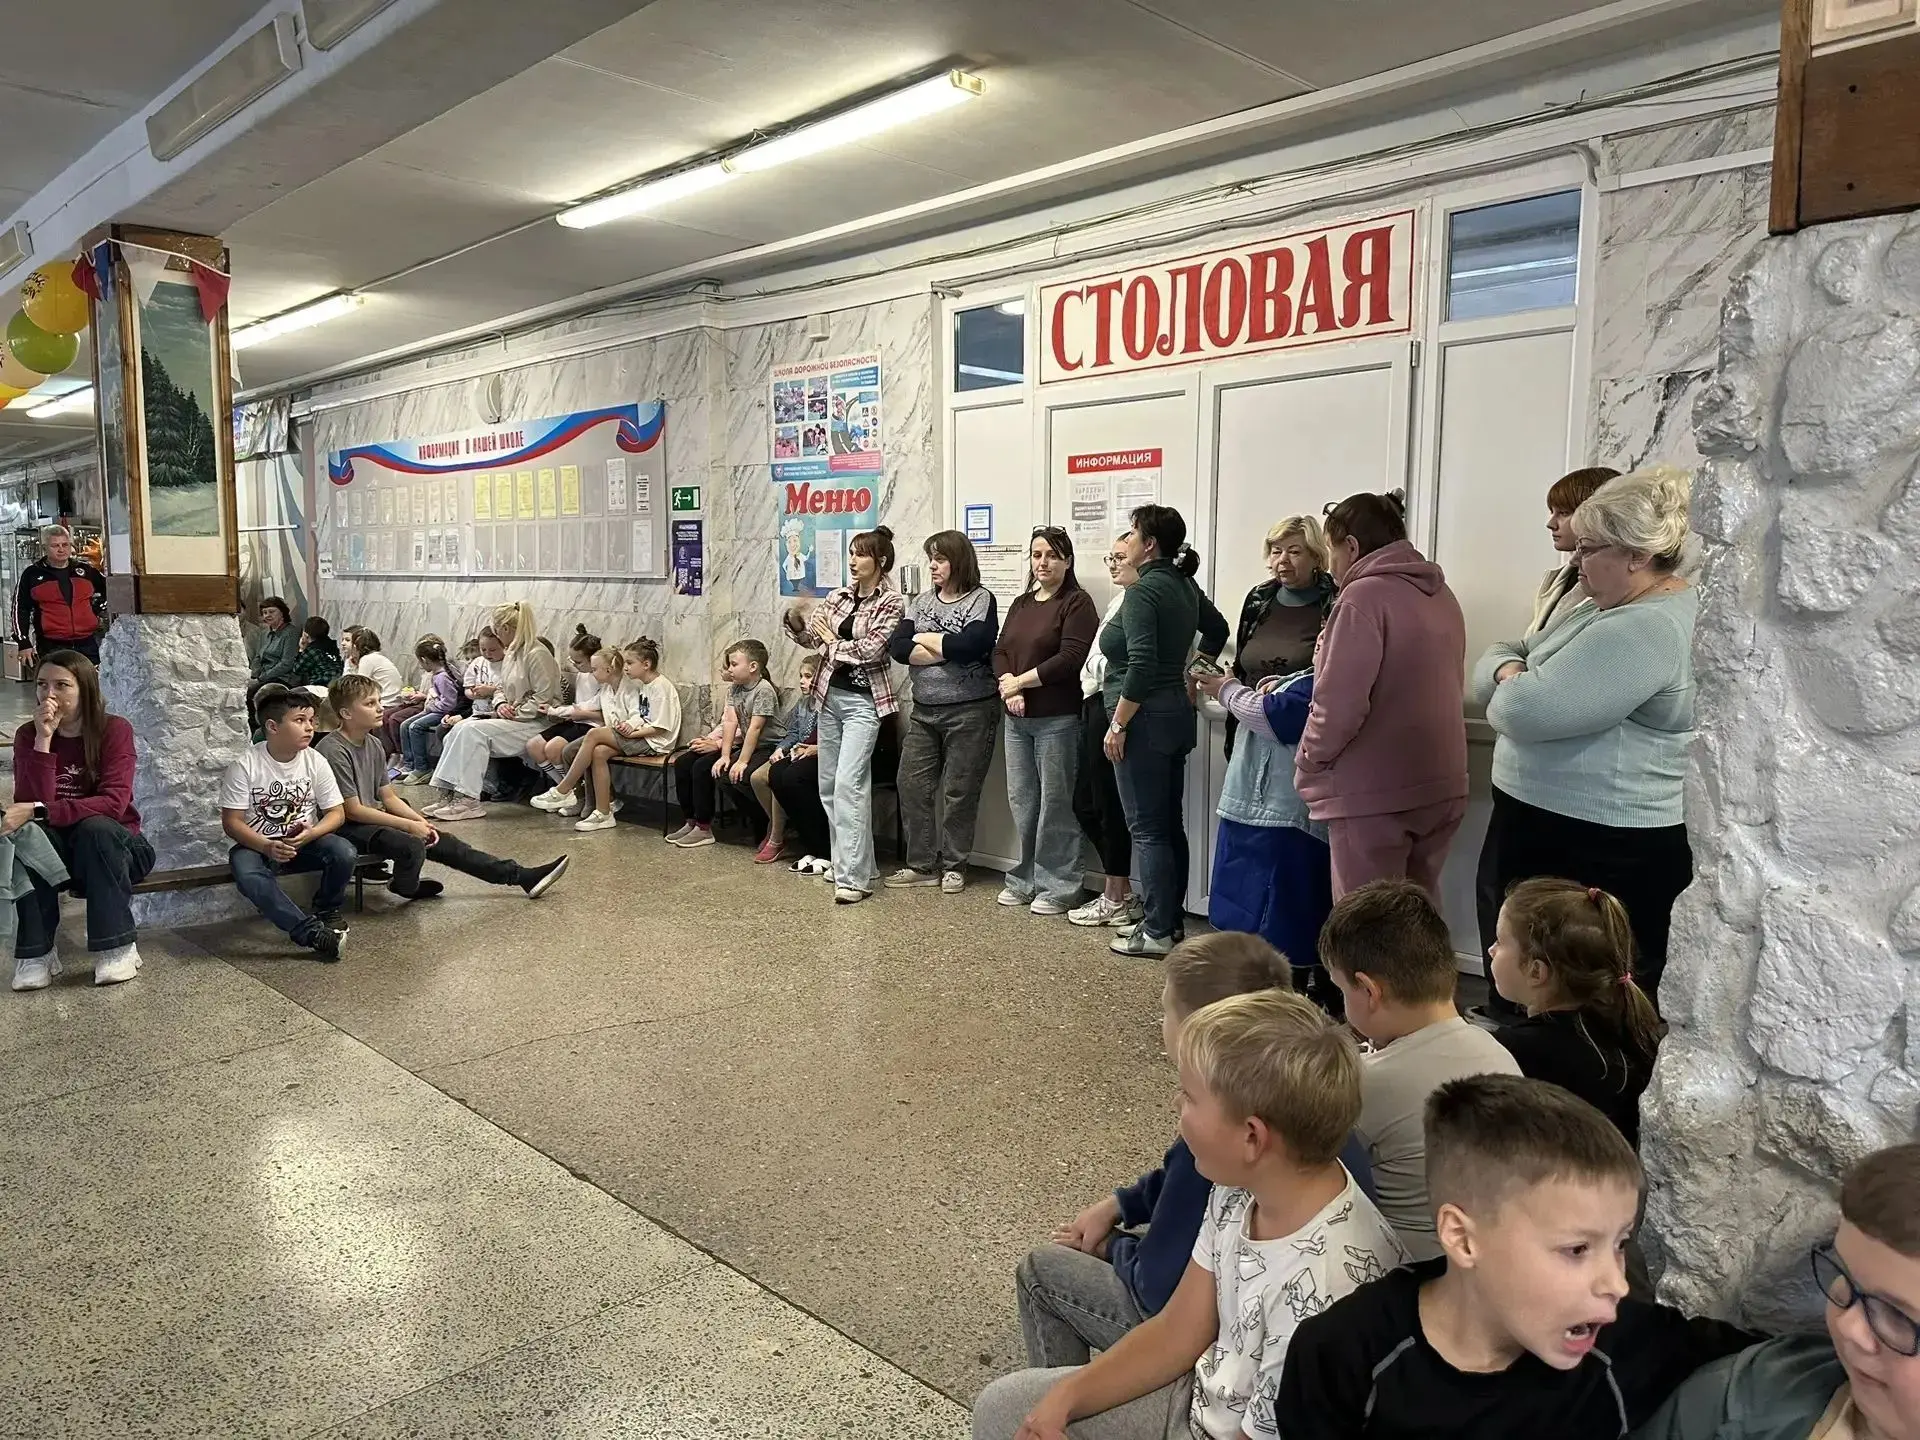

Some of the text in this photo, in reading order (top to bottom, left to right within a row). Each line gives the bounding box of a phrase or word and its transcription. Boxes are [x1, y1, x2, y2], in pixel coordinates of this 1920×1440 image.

[1052, 224, 1396, 371] СТОЛОВАЯ
[829, 355, 878, 369] БЕЗОПАСНОСТИ
[465, 438, 470, 454] О
[473, 432, 497, 453] НАШЕЙ
[499, 430, 524, 449] ШКОЛЕ
[1076, 453, 1152, 468] ИНФОРМАЦИЯ
[784, 481, 872, 515] Меню
